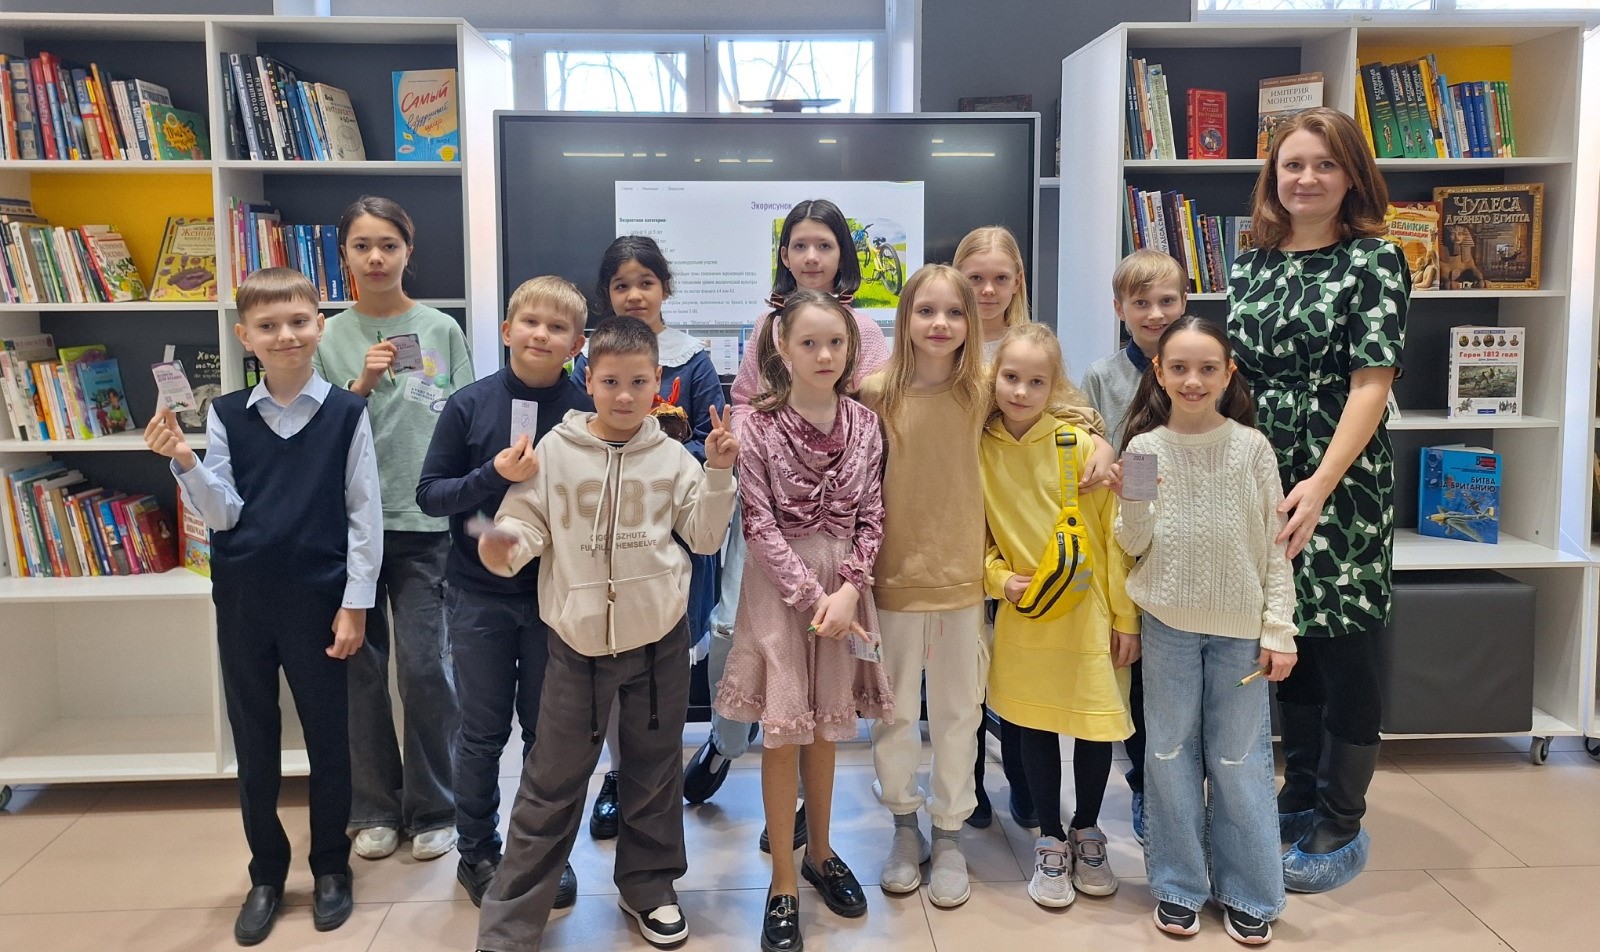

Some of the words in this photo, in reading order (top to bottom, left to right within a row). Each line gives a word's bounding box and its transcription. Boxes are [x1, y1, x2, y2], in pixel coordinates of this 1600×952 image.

[246, 72, 260, 117] МОТОЦИКЛЫ
[1270, 87, 1310, 98] ИМПЕРИЯ
[255, 77, 269, 121] МОТОЦИКЛЫ
[1267, 95, 1313, 105] МОНГОЛОВ
[751, 201, 792, 211] Экорисунок
[1453, 196, 1522, 215] ЧУДЕСА
[1444, 214, 1491, 226] ДРЕВНЕГО
[1492, 213, 1531, 224] ЕГИПТА
[1391, 221, 1430, 232] ВЕЛИКИЕ
[1471, 477, 1496, 485] БИТВА
[1451, 482, 1496, 493] БРИТАНИЮ
[555, 479, 672, 529] 1987
[615, 540, 657, 551] HEMSELVE
